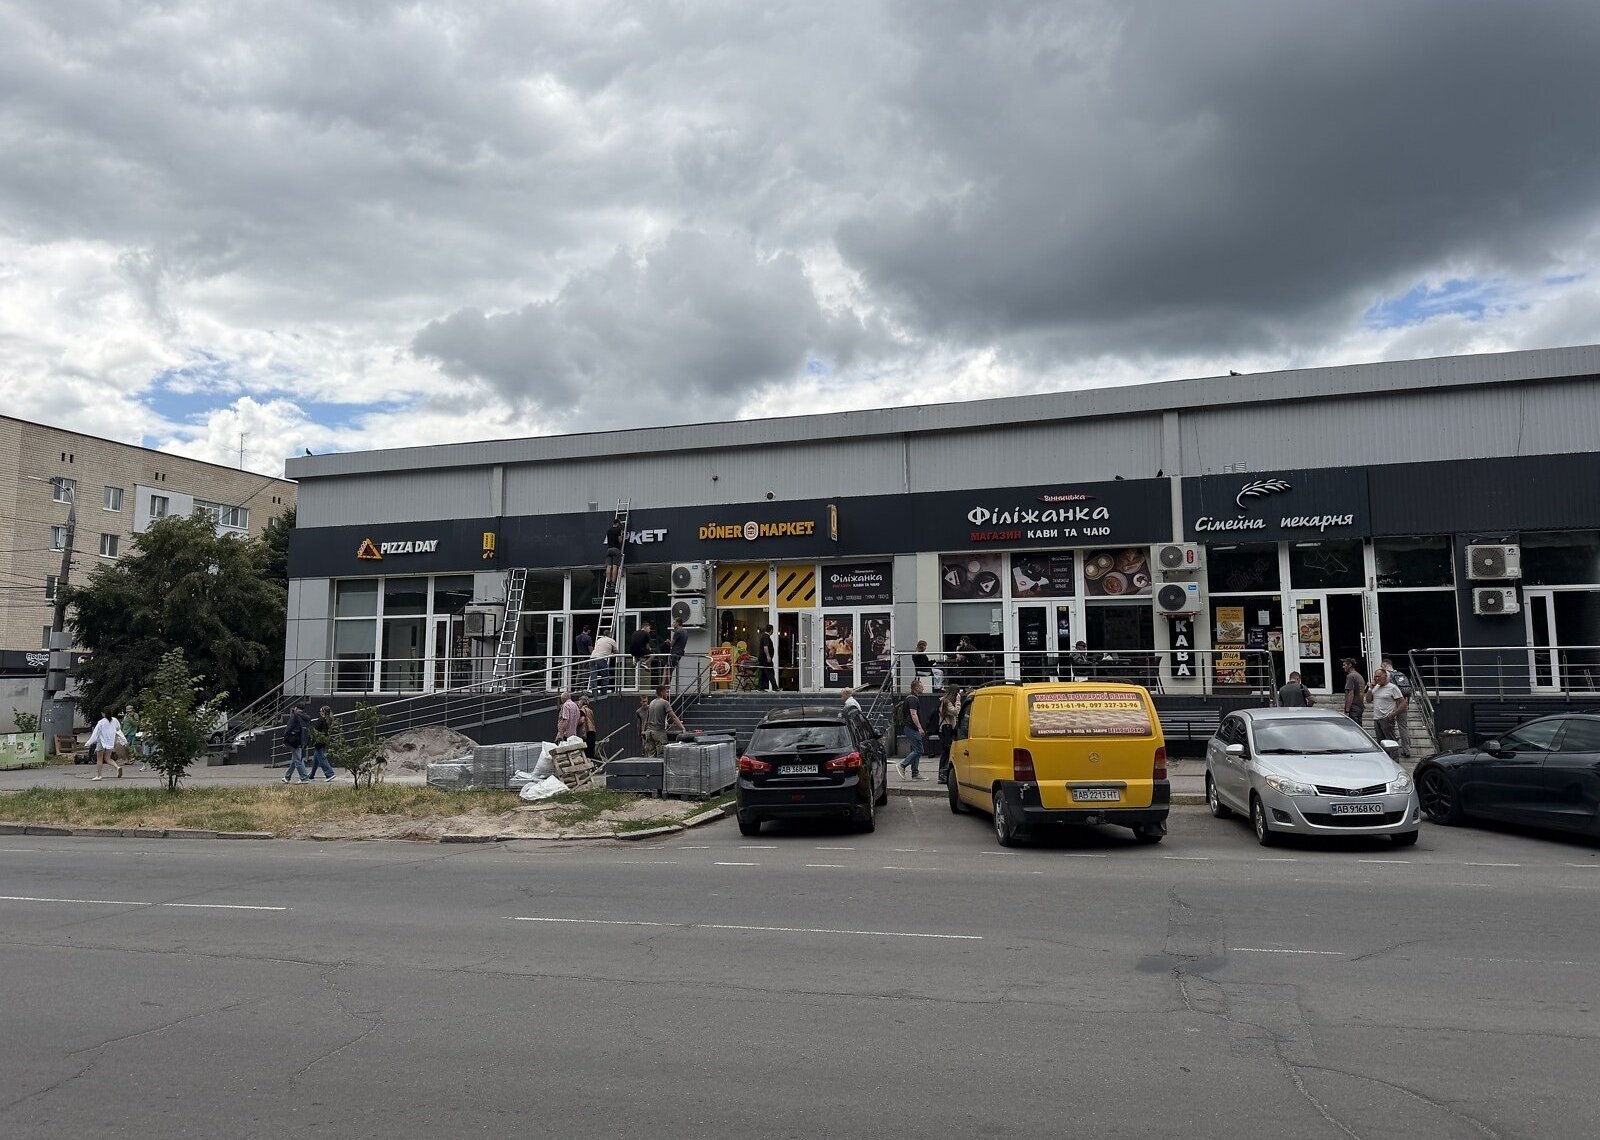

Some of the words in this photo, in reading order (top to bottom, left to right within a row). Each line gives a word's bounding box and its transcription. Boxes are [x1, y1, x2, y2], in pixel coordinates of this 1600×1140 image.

[967, 506, 1110, 526] Філіжанка
[1194, 514, 1267, 532] Сімейна
[1280, 513, 1354, 532] пекарня
[699, 522, 743, 540] DÖNER
[759, 521, 815, 537] МАРКЕТ
[970, 531, 1022, 541] МАГАЗИН
[1027, 529, 1058, 539] КАВИ
[1064, 528, 1078, 537] ТА
[1083, 526, 1111, 536] ЧАЮ
[380, 541, 413, 555] PIZZA
[414, 539, 439, 553] DAY
[830, 573, 883, 583] Філіжанка
[1174, 620, 1191, 676] КАВА
[1079, 791, 1088, 799] AB
[1089, 791, 1106, 799] 2213
[1337, 805, 1349, 813] AB
[1349, 804, 1369, 813] 9168
[1369, 804, 1382, 813] KO
